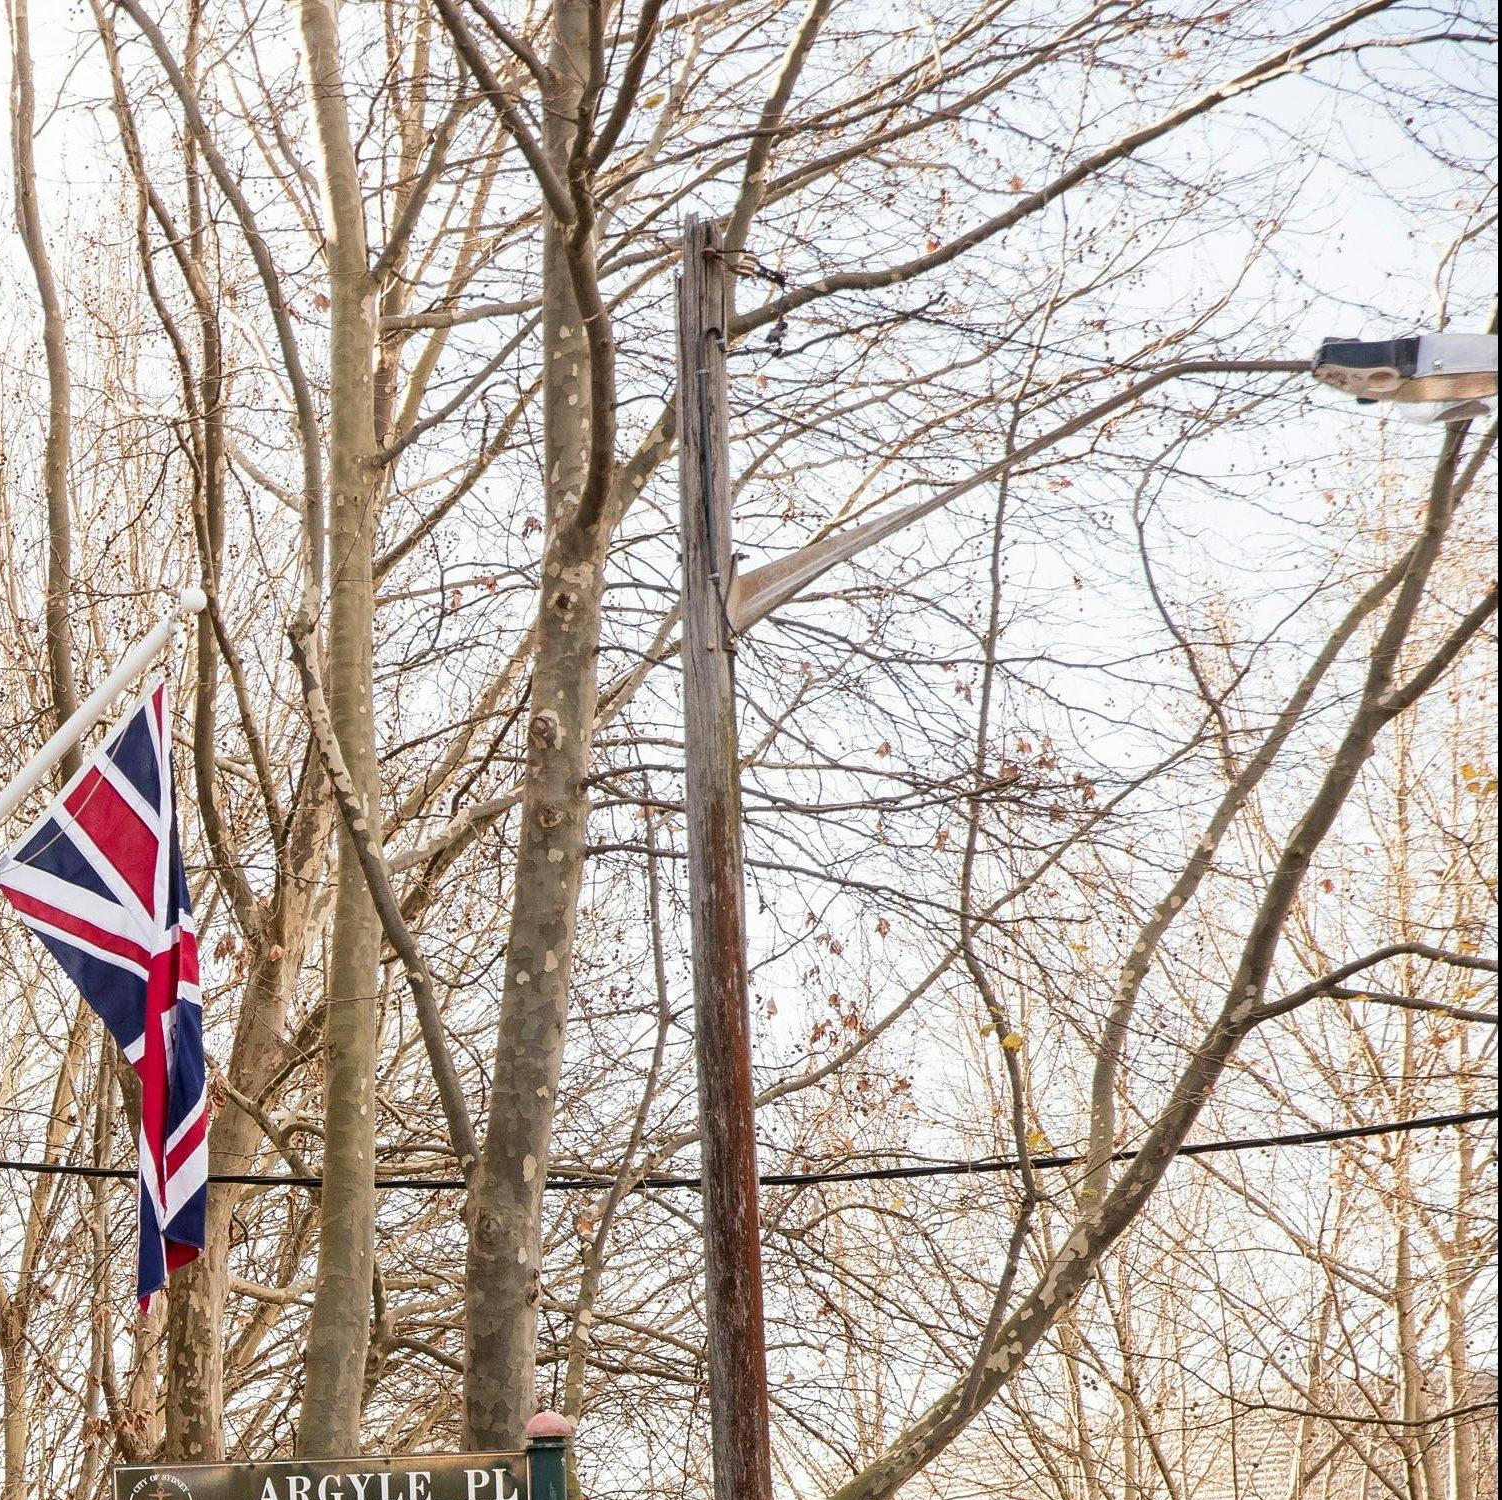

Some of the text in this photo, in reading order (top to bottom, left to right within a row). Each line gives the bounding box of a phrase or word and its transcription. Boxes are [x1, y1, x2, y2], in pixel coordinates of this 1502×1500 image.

[133, 1473, 190, 1494] CITY OF SYDNEY
